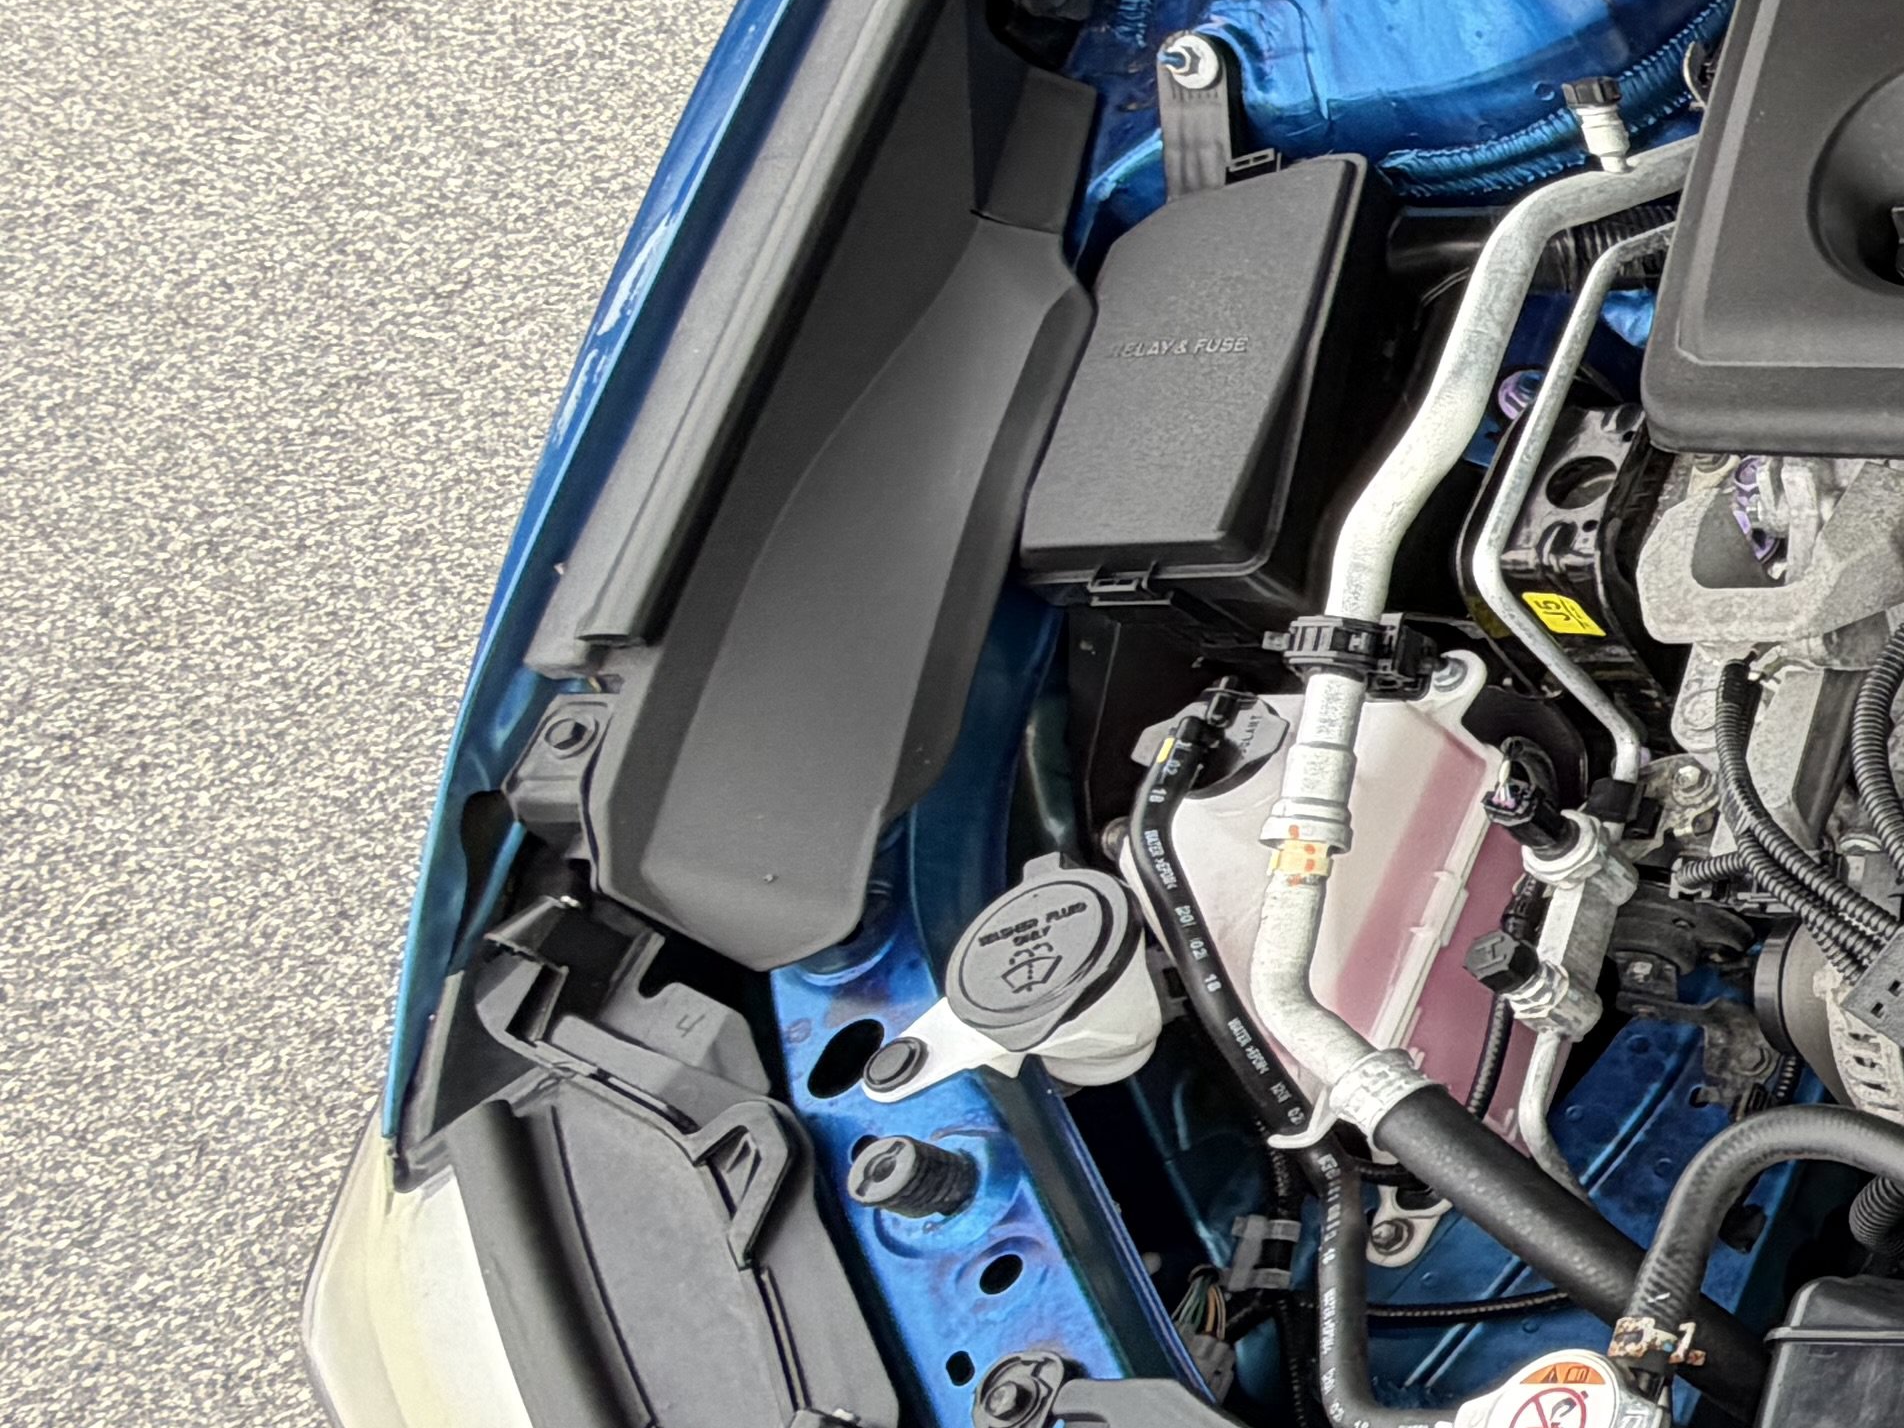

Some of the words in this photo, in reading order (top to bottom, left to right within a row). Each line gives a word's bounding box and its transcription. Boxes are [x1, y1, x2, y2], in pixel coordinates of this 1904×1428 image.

[1174, 339, 1188, 355] &
[1193, 336, 1249, 355] FUSE
[675, 1013, 706, 1039] 4
